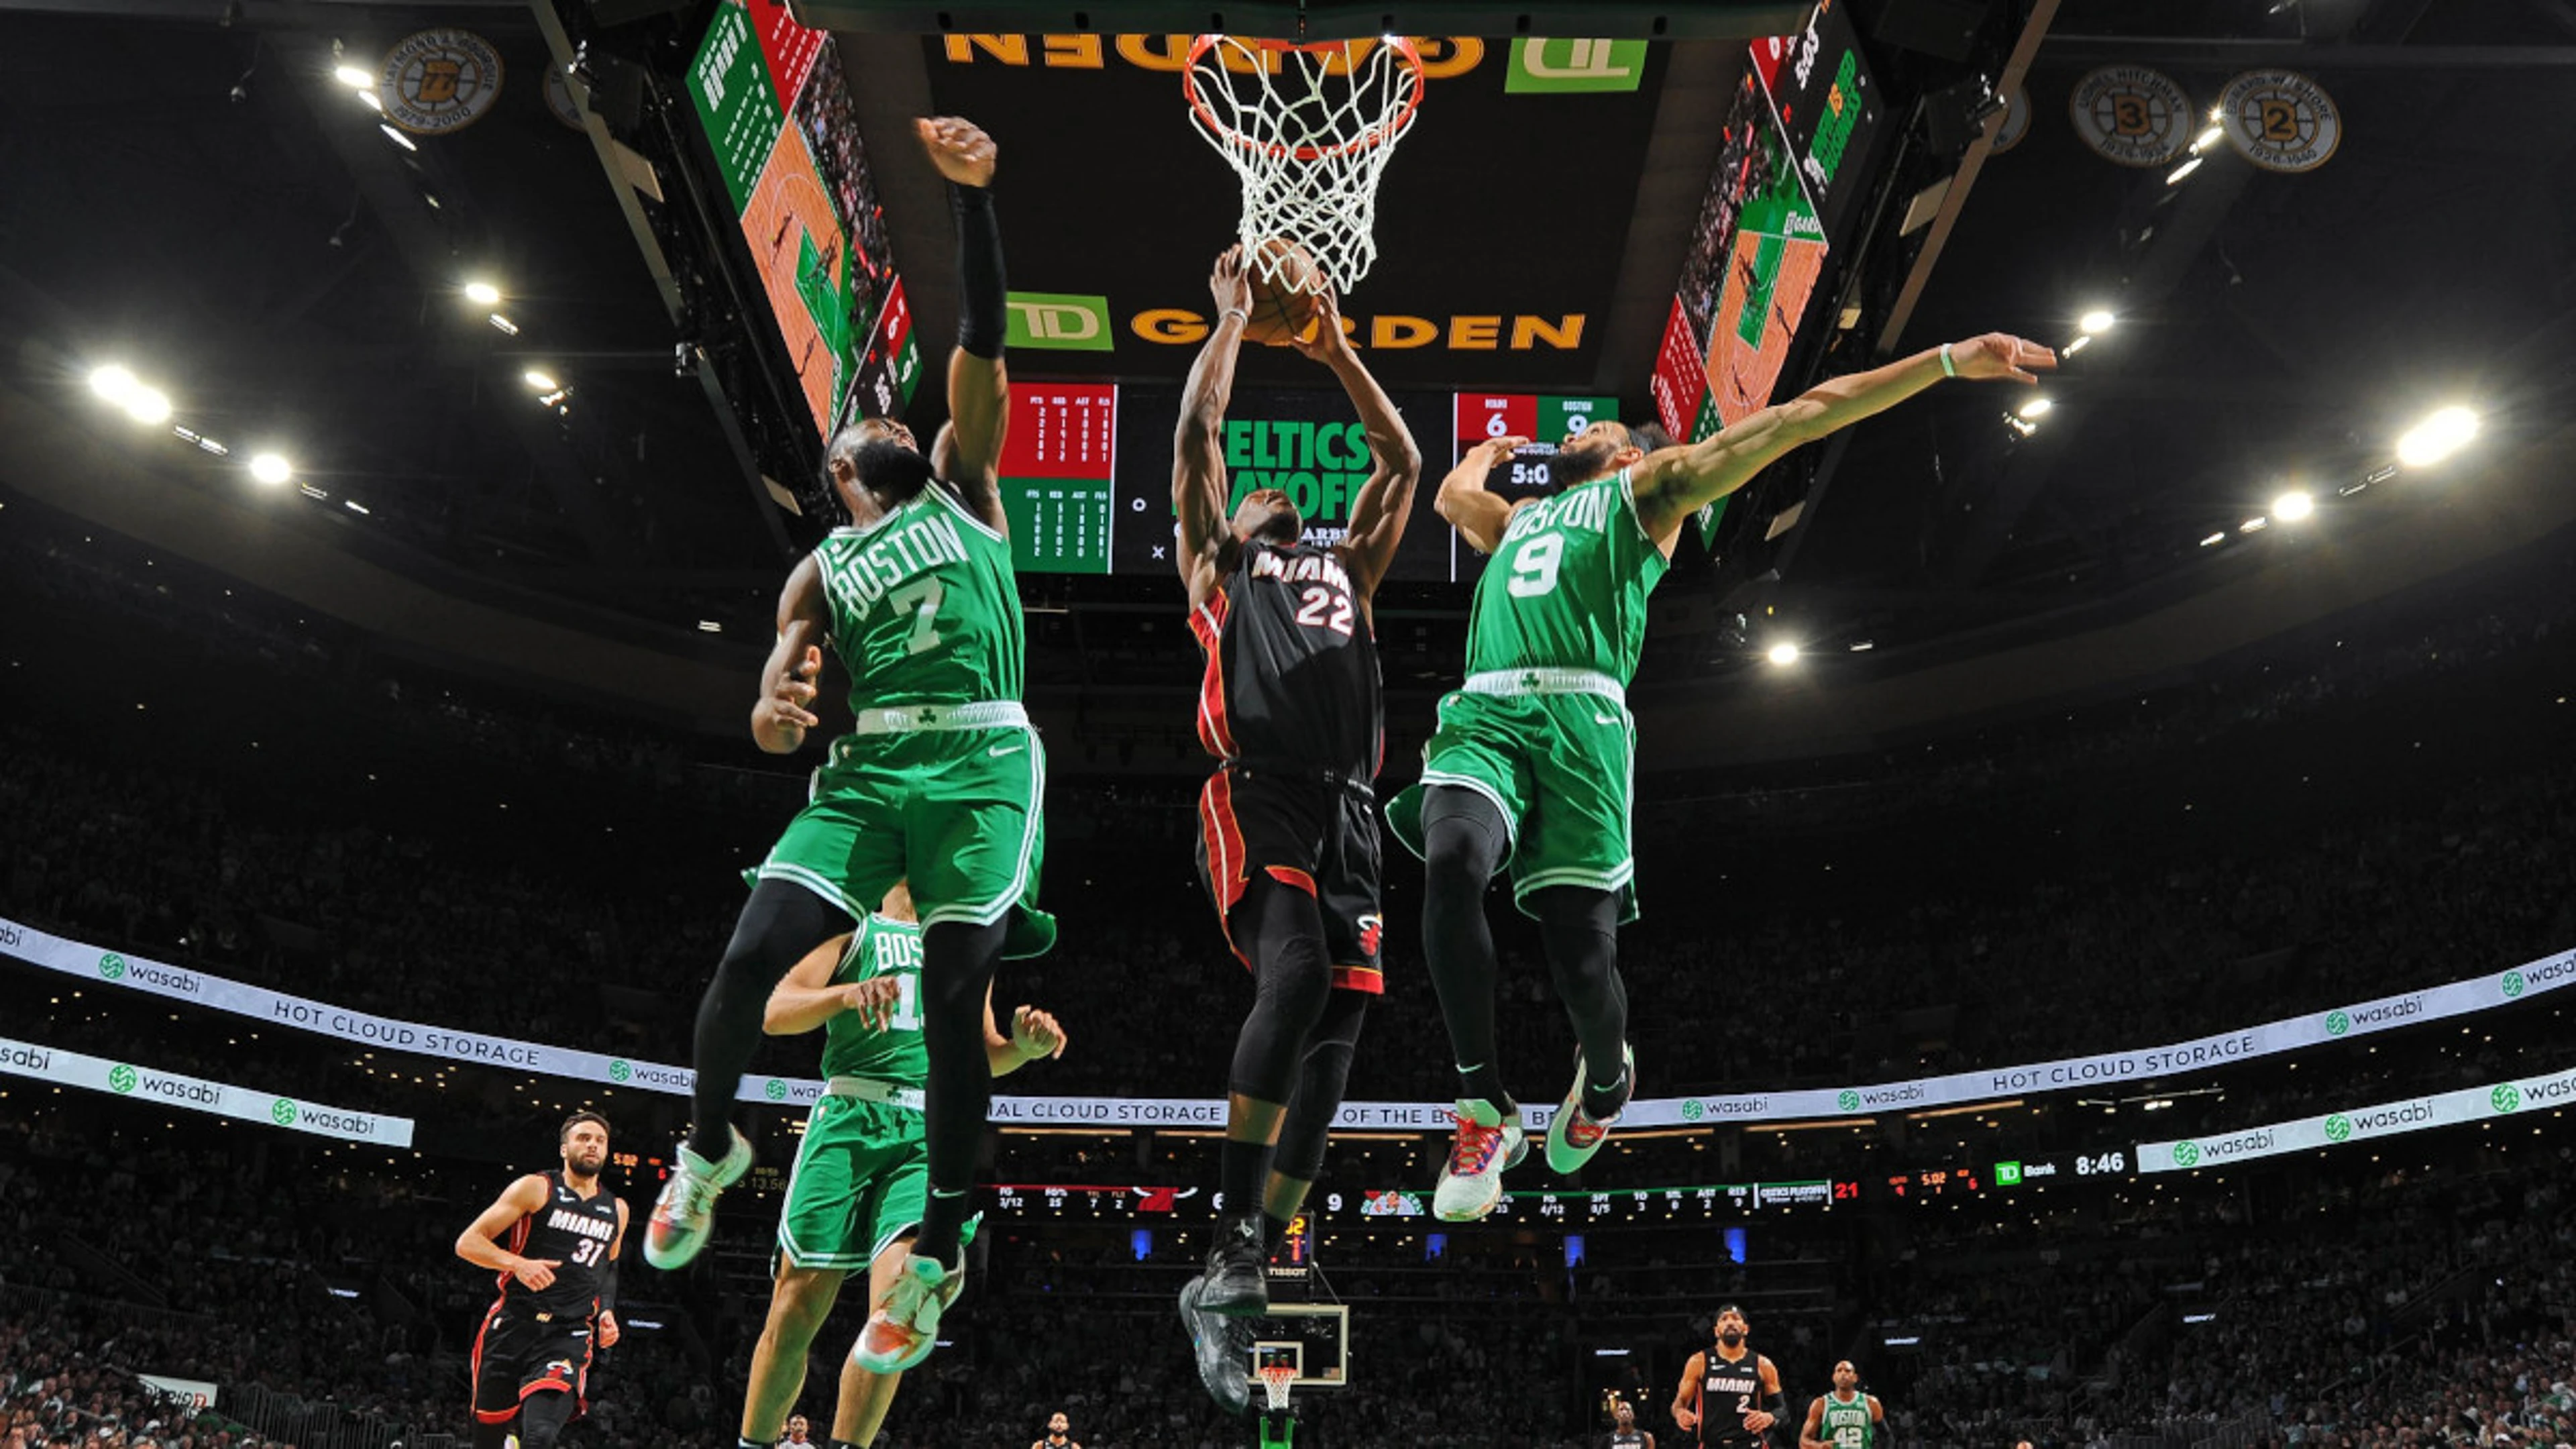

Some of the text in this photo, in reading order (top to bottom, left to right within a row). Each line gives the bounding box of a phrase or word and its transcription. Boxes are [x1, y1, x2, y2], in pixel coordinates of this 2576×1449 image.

[2121, 102, 2143, 127] 3
[2266, 107, 2292, 133] 2
[1006, 301, 1587, 350] TD GRDEN
[1487, 413, 1588, 438] 6 9
[1221, 421, 1371, 471] ELTICS
[832, 512, 971, 622] BOSTON
[1507, 531, 1564, 598] 9
[888, 573, 943, 655] 7
[1295, 586, 1354, 637] 22
[130, 963, 202, 994] wasabi
[2526, 953, 2576, 985] wasa
[892, 973, 924, 1031] 1
[2352, 996, 2423, 1026] wasabi
[274, 1001, 540, 1066] HOT CLOUD STORAGE
[1992, 1035, 2256, 1091] HOT CLOUD STORAGE
[142, 1075, 222, 1105] wasabi
[1707, 1095, 1769, 1114] wasabi
[1864, 1083, 1925, 1106] wasabi
[302, 1106, 375, 1134] wasabi
[1031, 1103, 1108, 1118] CLOUD
[1118, 1104, 1221, 1121] STORAGE
[1343, 1109, 1370, 1123] OF
[1380, 1109, 1422, 1124] THE
[2354, 1099, 2434, 1131] wasabi
[2204, 1128, 2274, 1159] wasabi
[1998, 1161, 2056, 1181] TD Bank
[2076, 1151, 2125, 1175] 8:46
[1326, 1193, 1342, 1212] 9
[1835, 1182, 1859, 1199] 21
[547, 1208, 614, 1242] MIAMI
[570, 1238, 605, 1268] 31
[1268, 1267, 1307, 1277] TISSOT
[1705, 1377, 1757, 1393] MIAMI
[1735, 1395, 1751, 1413] 2
[1833, 1427, 1863, 1448] 42
